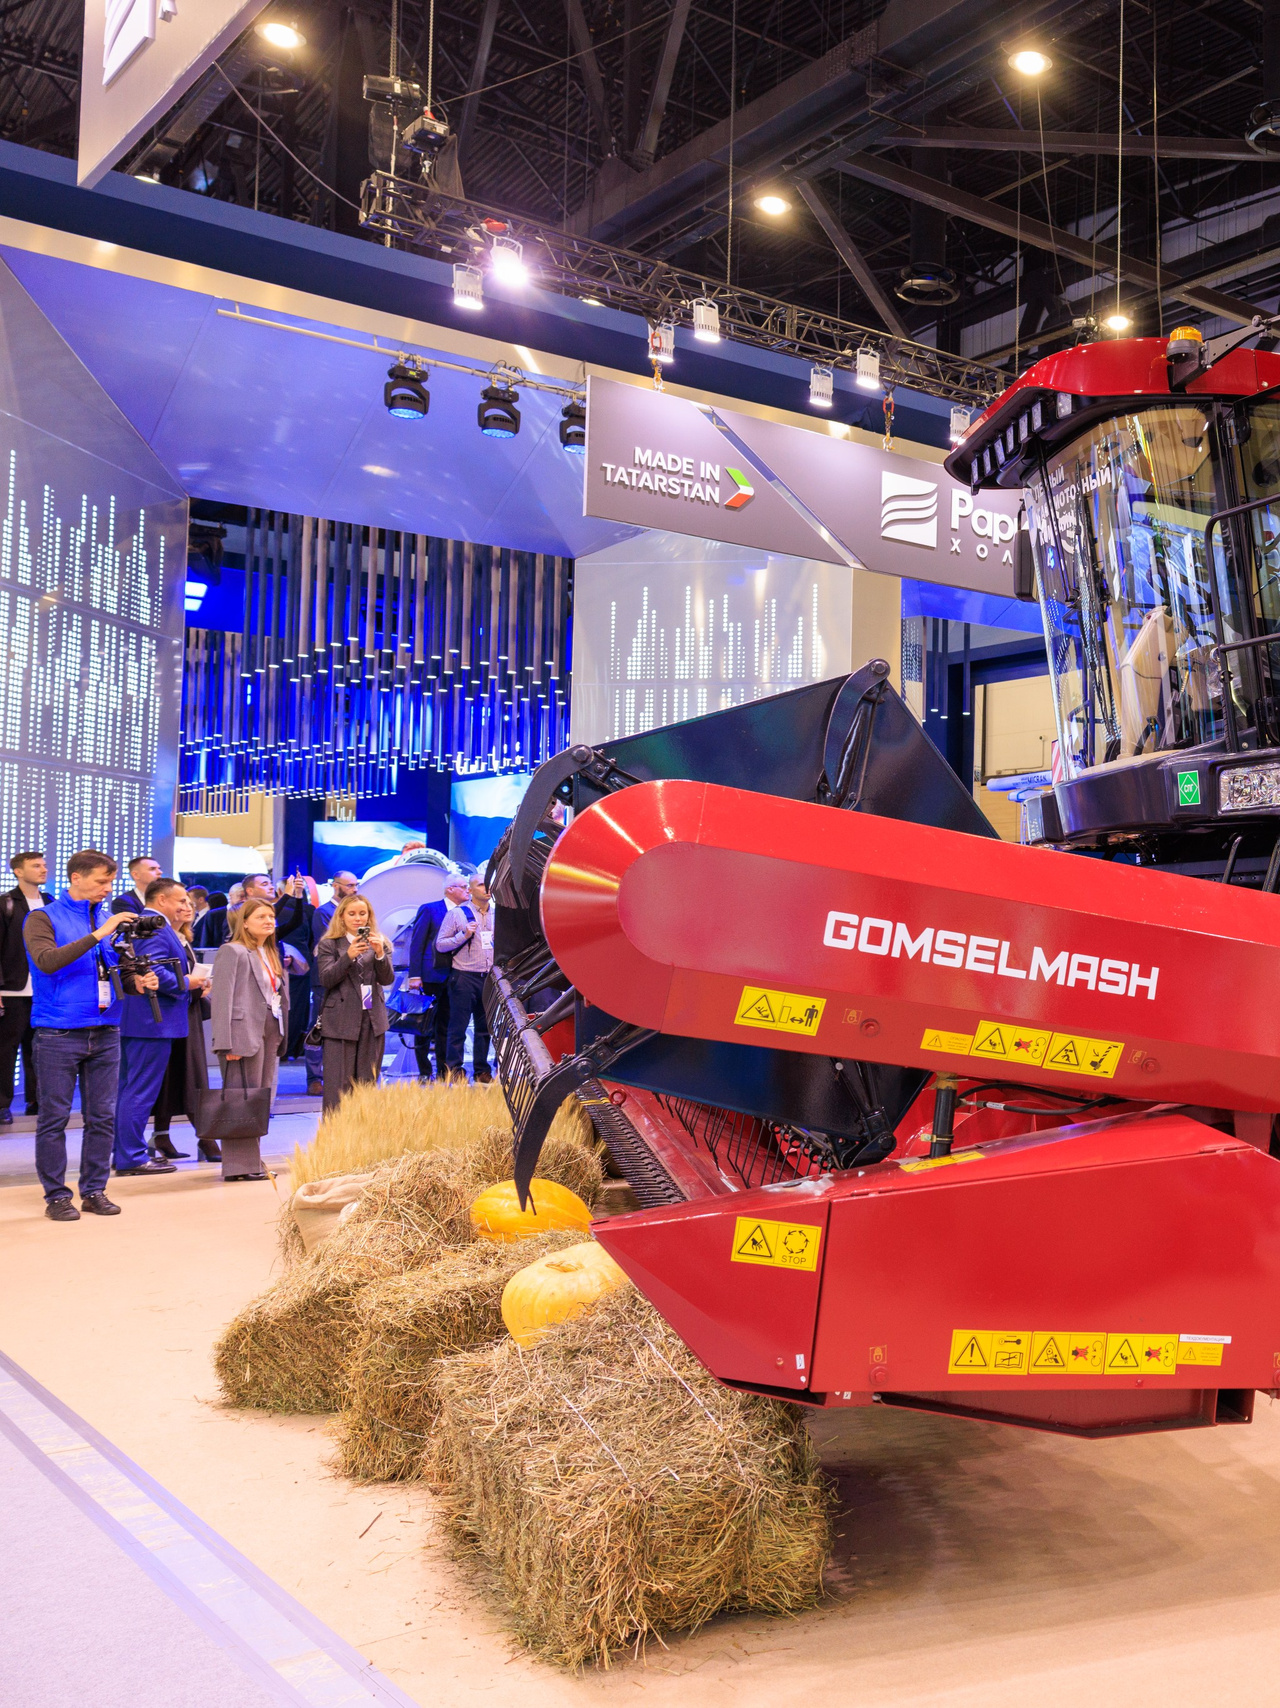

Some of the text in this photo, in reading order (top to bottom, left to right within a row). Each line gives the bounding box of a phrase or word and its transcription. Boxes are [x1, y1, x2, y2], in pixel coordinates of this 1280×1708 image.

[602, 462, 720, 504] TATARSTAN
[634, 446, 720, 482] MADE IN
[823, 910, 1160, 1001] GOMSELMASH
[781, 1255, 807, 1265] STOP
